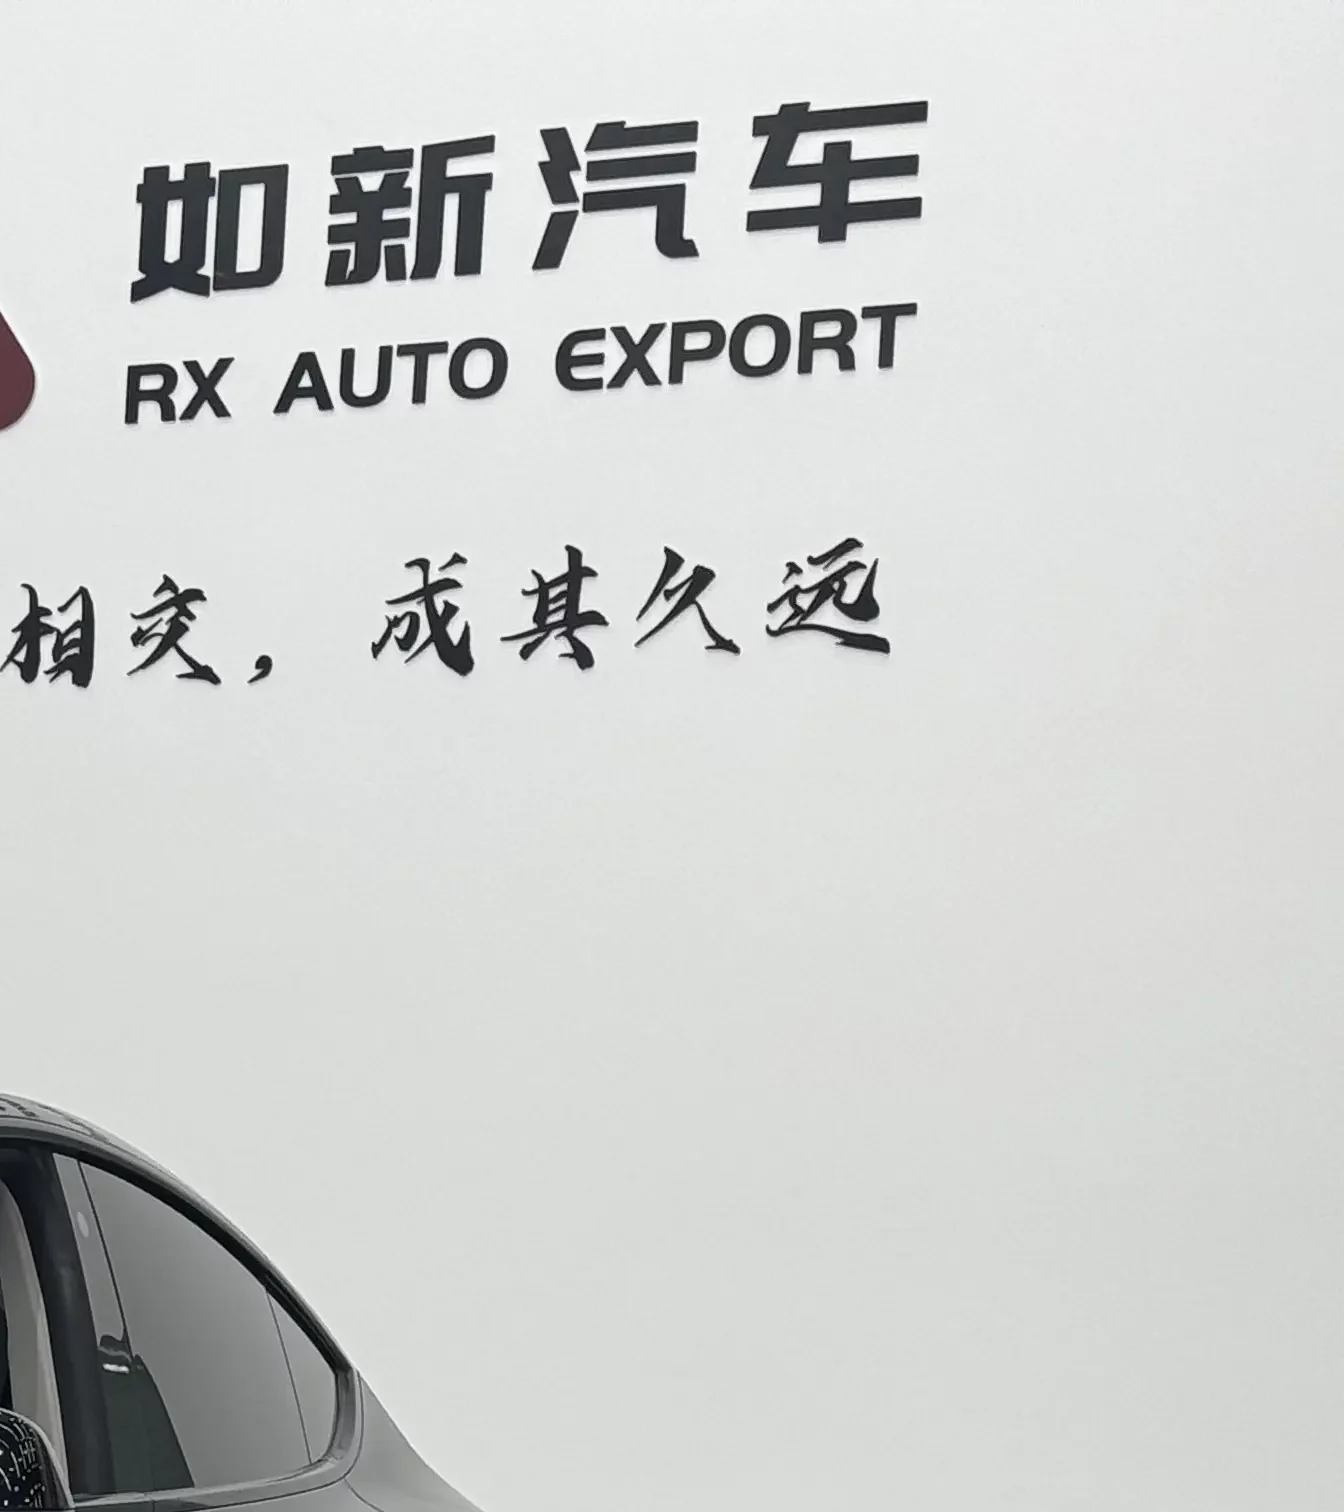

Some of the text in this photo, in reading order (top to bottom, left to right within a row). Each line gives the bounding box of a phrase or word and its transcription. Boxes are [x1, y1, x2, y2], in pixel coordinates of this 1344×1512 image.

[130, 100, 929, 303] 如新汽车
[124, 302, 918, 425] RX AUTO EXPORT
